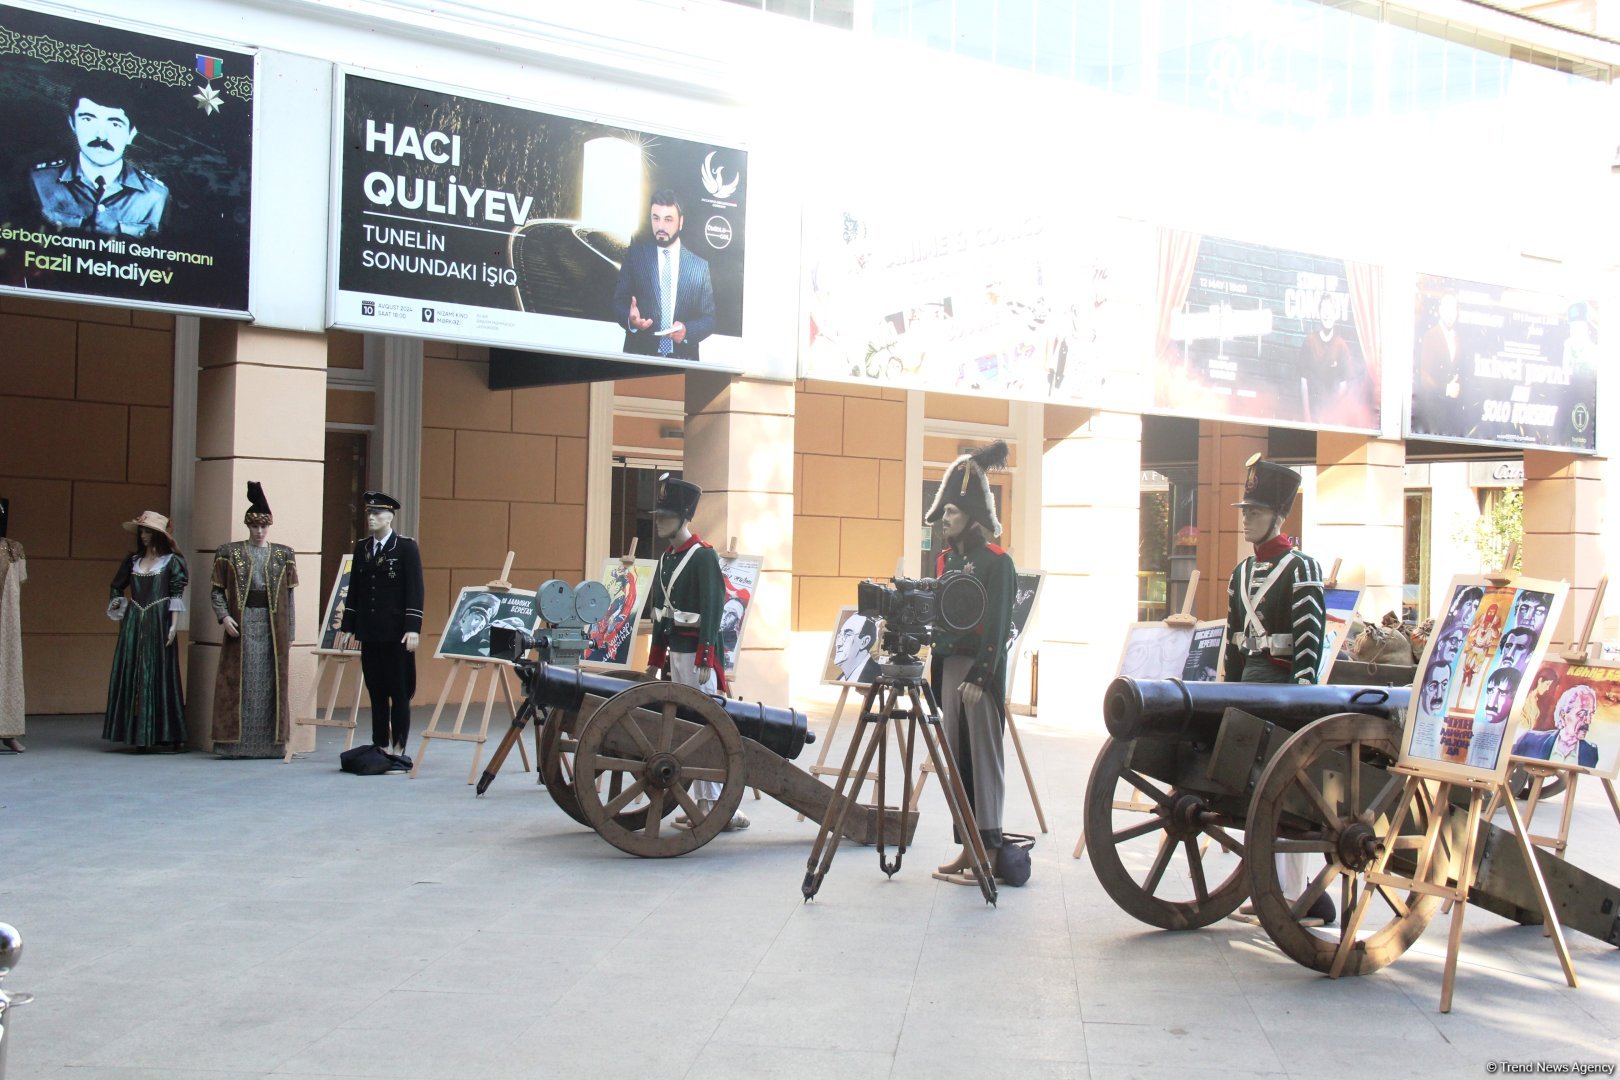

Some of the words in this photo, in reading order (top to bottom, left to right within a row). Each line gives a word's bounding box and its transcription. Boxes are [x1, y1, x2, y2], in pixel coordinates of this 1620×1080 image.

[365, 118, 461, 167] HACI
[362, 170, 534, 226] QULİYEV
[0, 228, 96, 251] ərbaycanın
[99, 239, 126, 255] Milli
[128, 243, 214, 267] Qəhrəmanı
[362, 223, 446, 252] TUNELİN
[24, 250, 72, 273] Fazil
[76, 256, 174, 287] Mehdiyev
[362, 249, 477, 282] SONUNDAKI
[482, 260, 519, 288] İŞIQ
[363, 305, 373, 315] 10
[377, 303, 399, 311] AVQUST
[400, 305, 413, 313] 2024
[377, 310, 392, 318] SAAT
